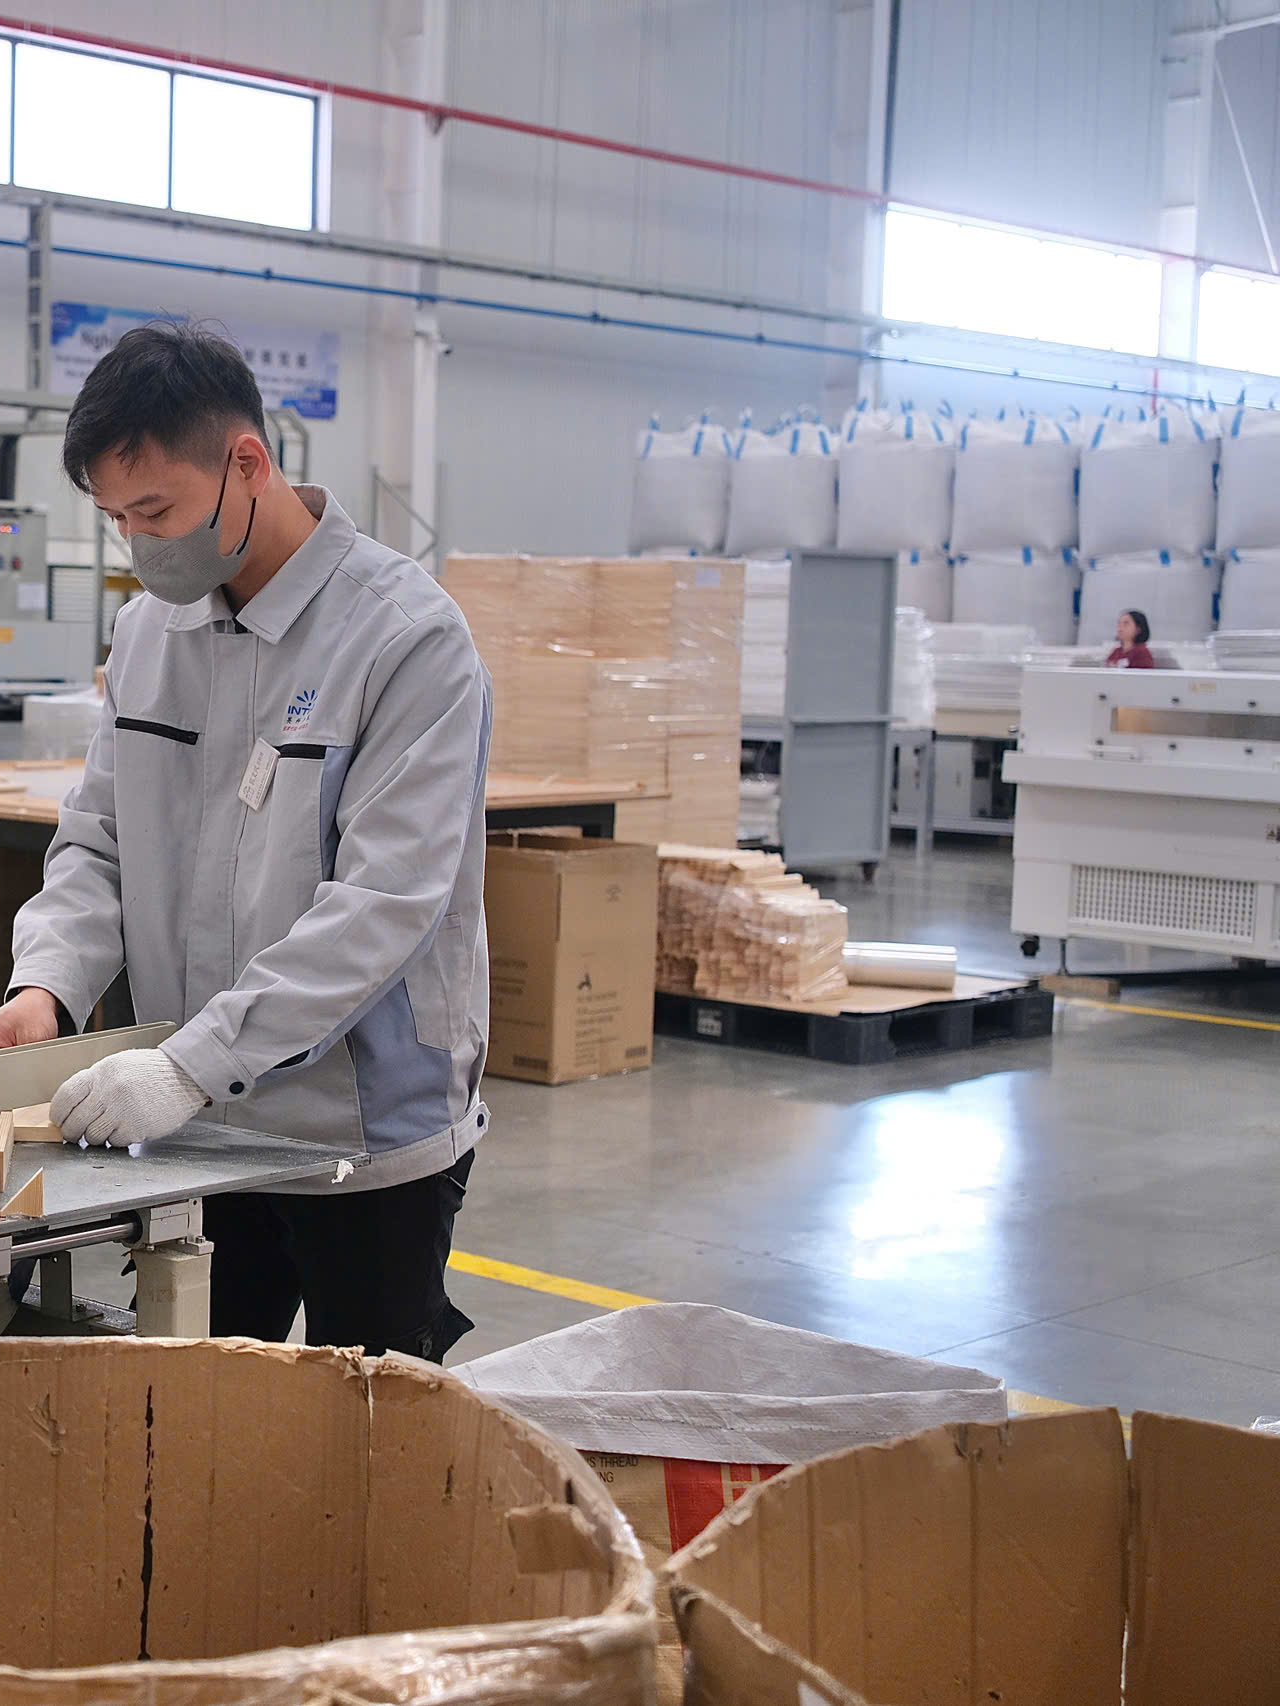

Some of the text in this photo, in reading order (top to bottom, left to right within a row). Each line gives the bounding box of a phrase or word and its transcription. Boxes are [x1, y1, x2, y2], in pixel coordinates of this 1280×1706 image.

[287, 705, 311, 716] INT
[599, 1456, 639, 1468] THREAD
[597, 1471, 614, 1483] NG
